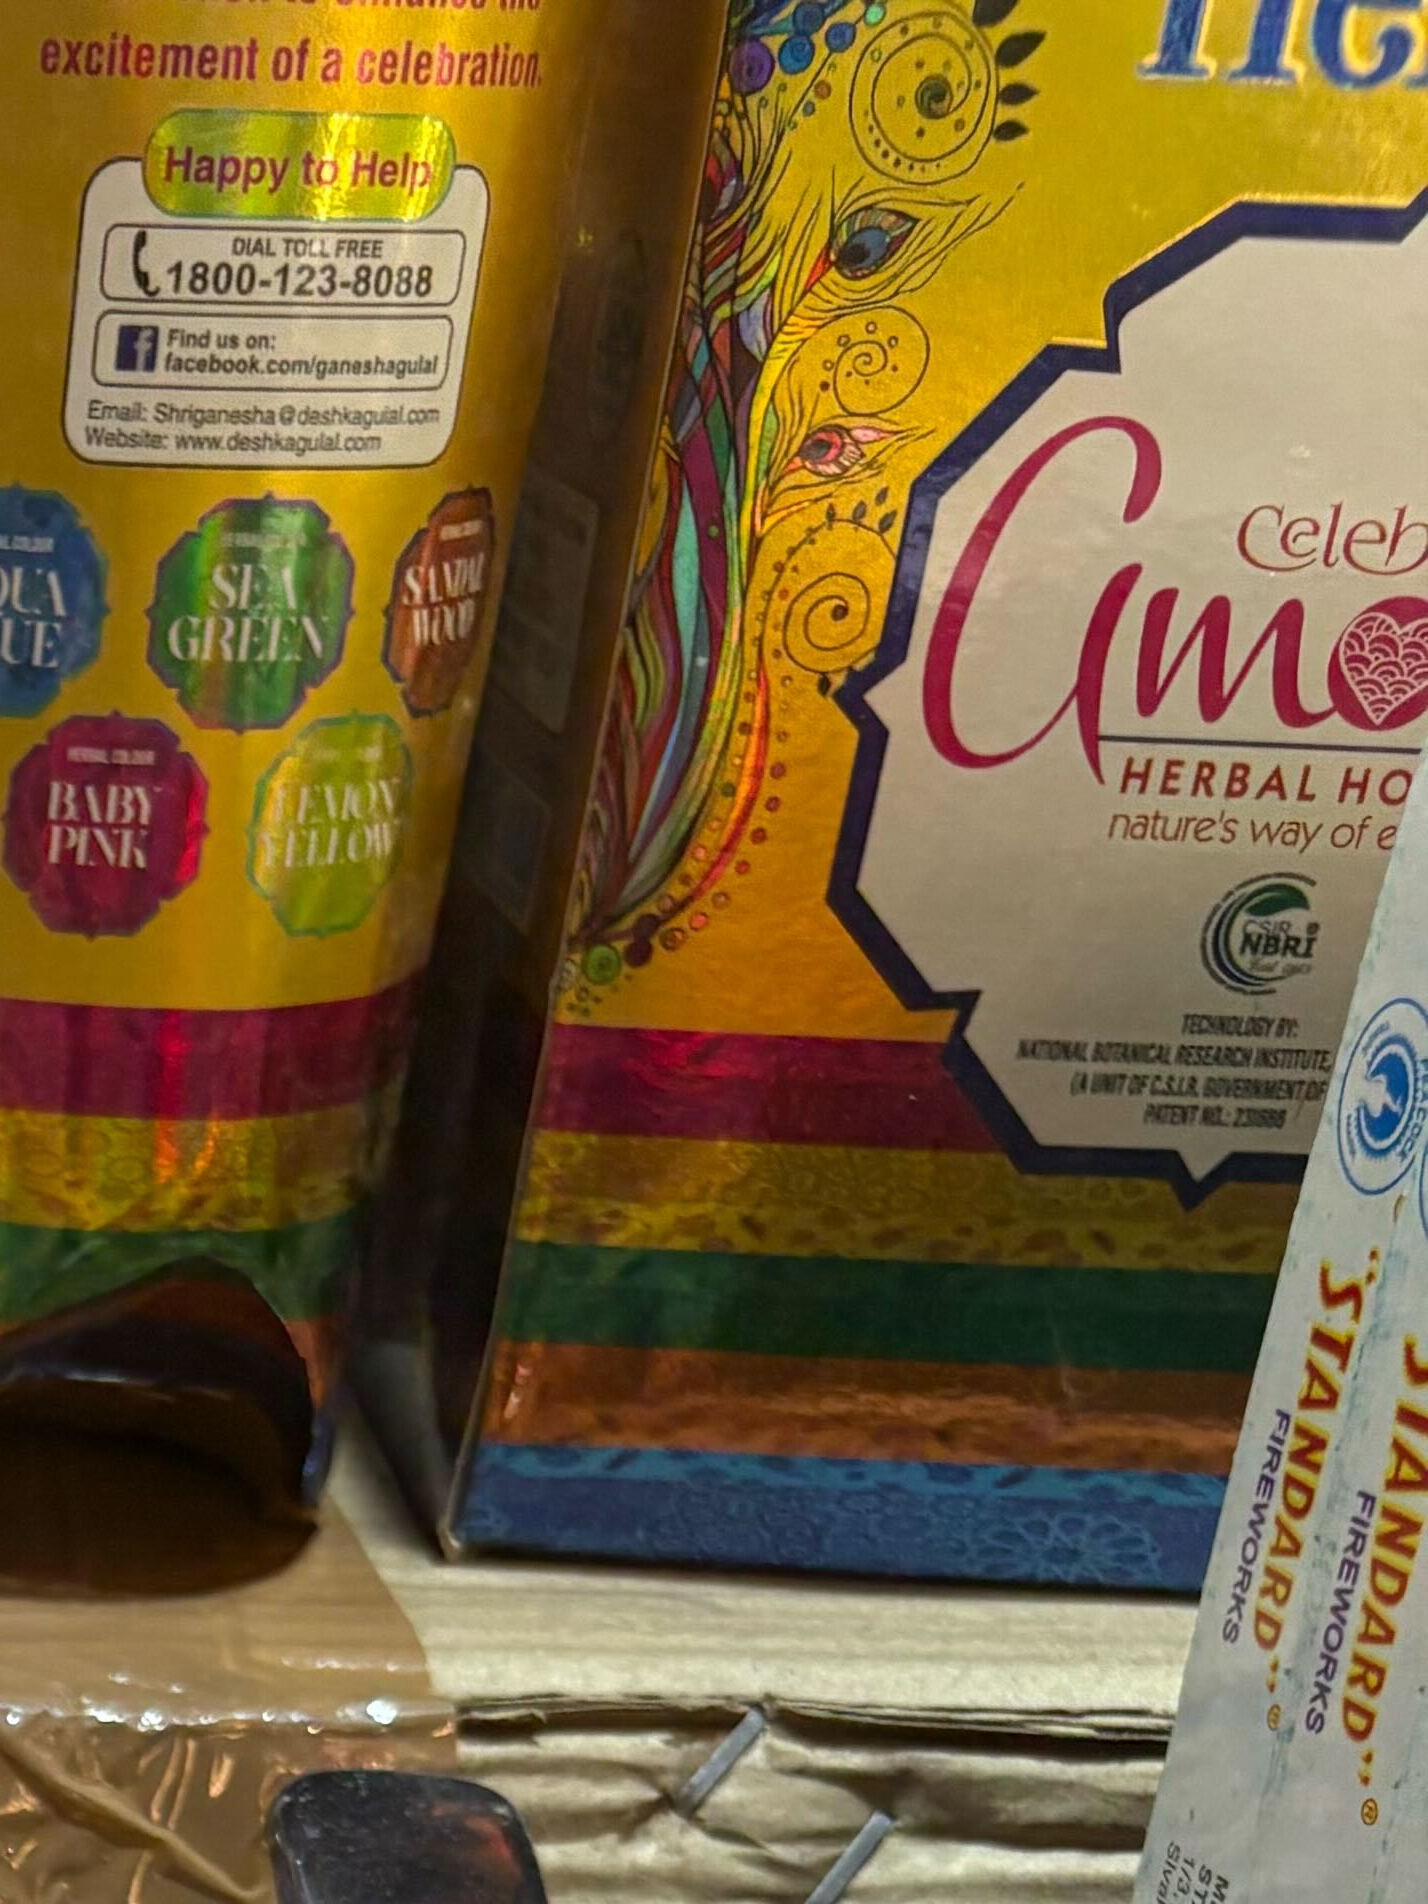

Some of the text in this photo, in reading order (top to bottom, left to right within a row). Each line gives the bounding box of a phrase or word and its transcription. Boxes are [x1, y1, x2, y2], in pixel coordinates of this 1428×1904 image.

[40, 33, 542, 90] excitement of a celebration.
[163, 145, 432, 195] Happy to Help
[232, 238, 384, 258] DIAL TOLL FREE
[167, 259, 433, 298] 1800-123-8088
[167, 328, 277, 352] Find us on:
[164, 353, 438, 380] facebook.com/ganeshagulal
[87, 400, 148, 423] Email:
[85, 425, 168, 450] Website:
[209, 562, 296, 612] SEA
[169, 615, 328, 663] GREEN
[48, 780, 161, 826] BABY
[275, 778, 400, 826] LEMON
[1119, 757, 1316, 803] HERBAL
[48, 825, 147, 869] PINK
[259, 820, 398, 869] YELLOW
[1107, 810, 1241, 843] nature's
[1251, 819, 1323, 854] way
[1330, 816, 1372, 851] of
[1240, 930, 1318, 958] NBRI
[1222, 1408, 1292, 1644] FIREWORKS
[1304, 1491, 1376, 1735] FIREWORKS
